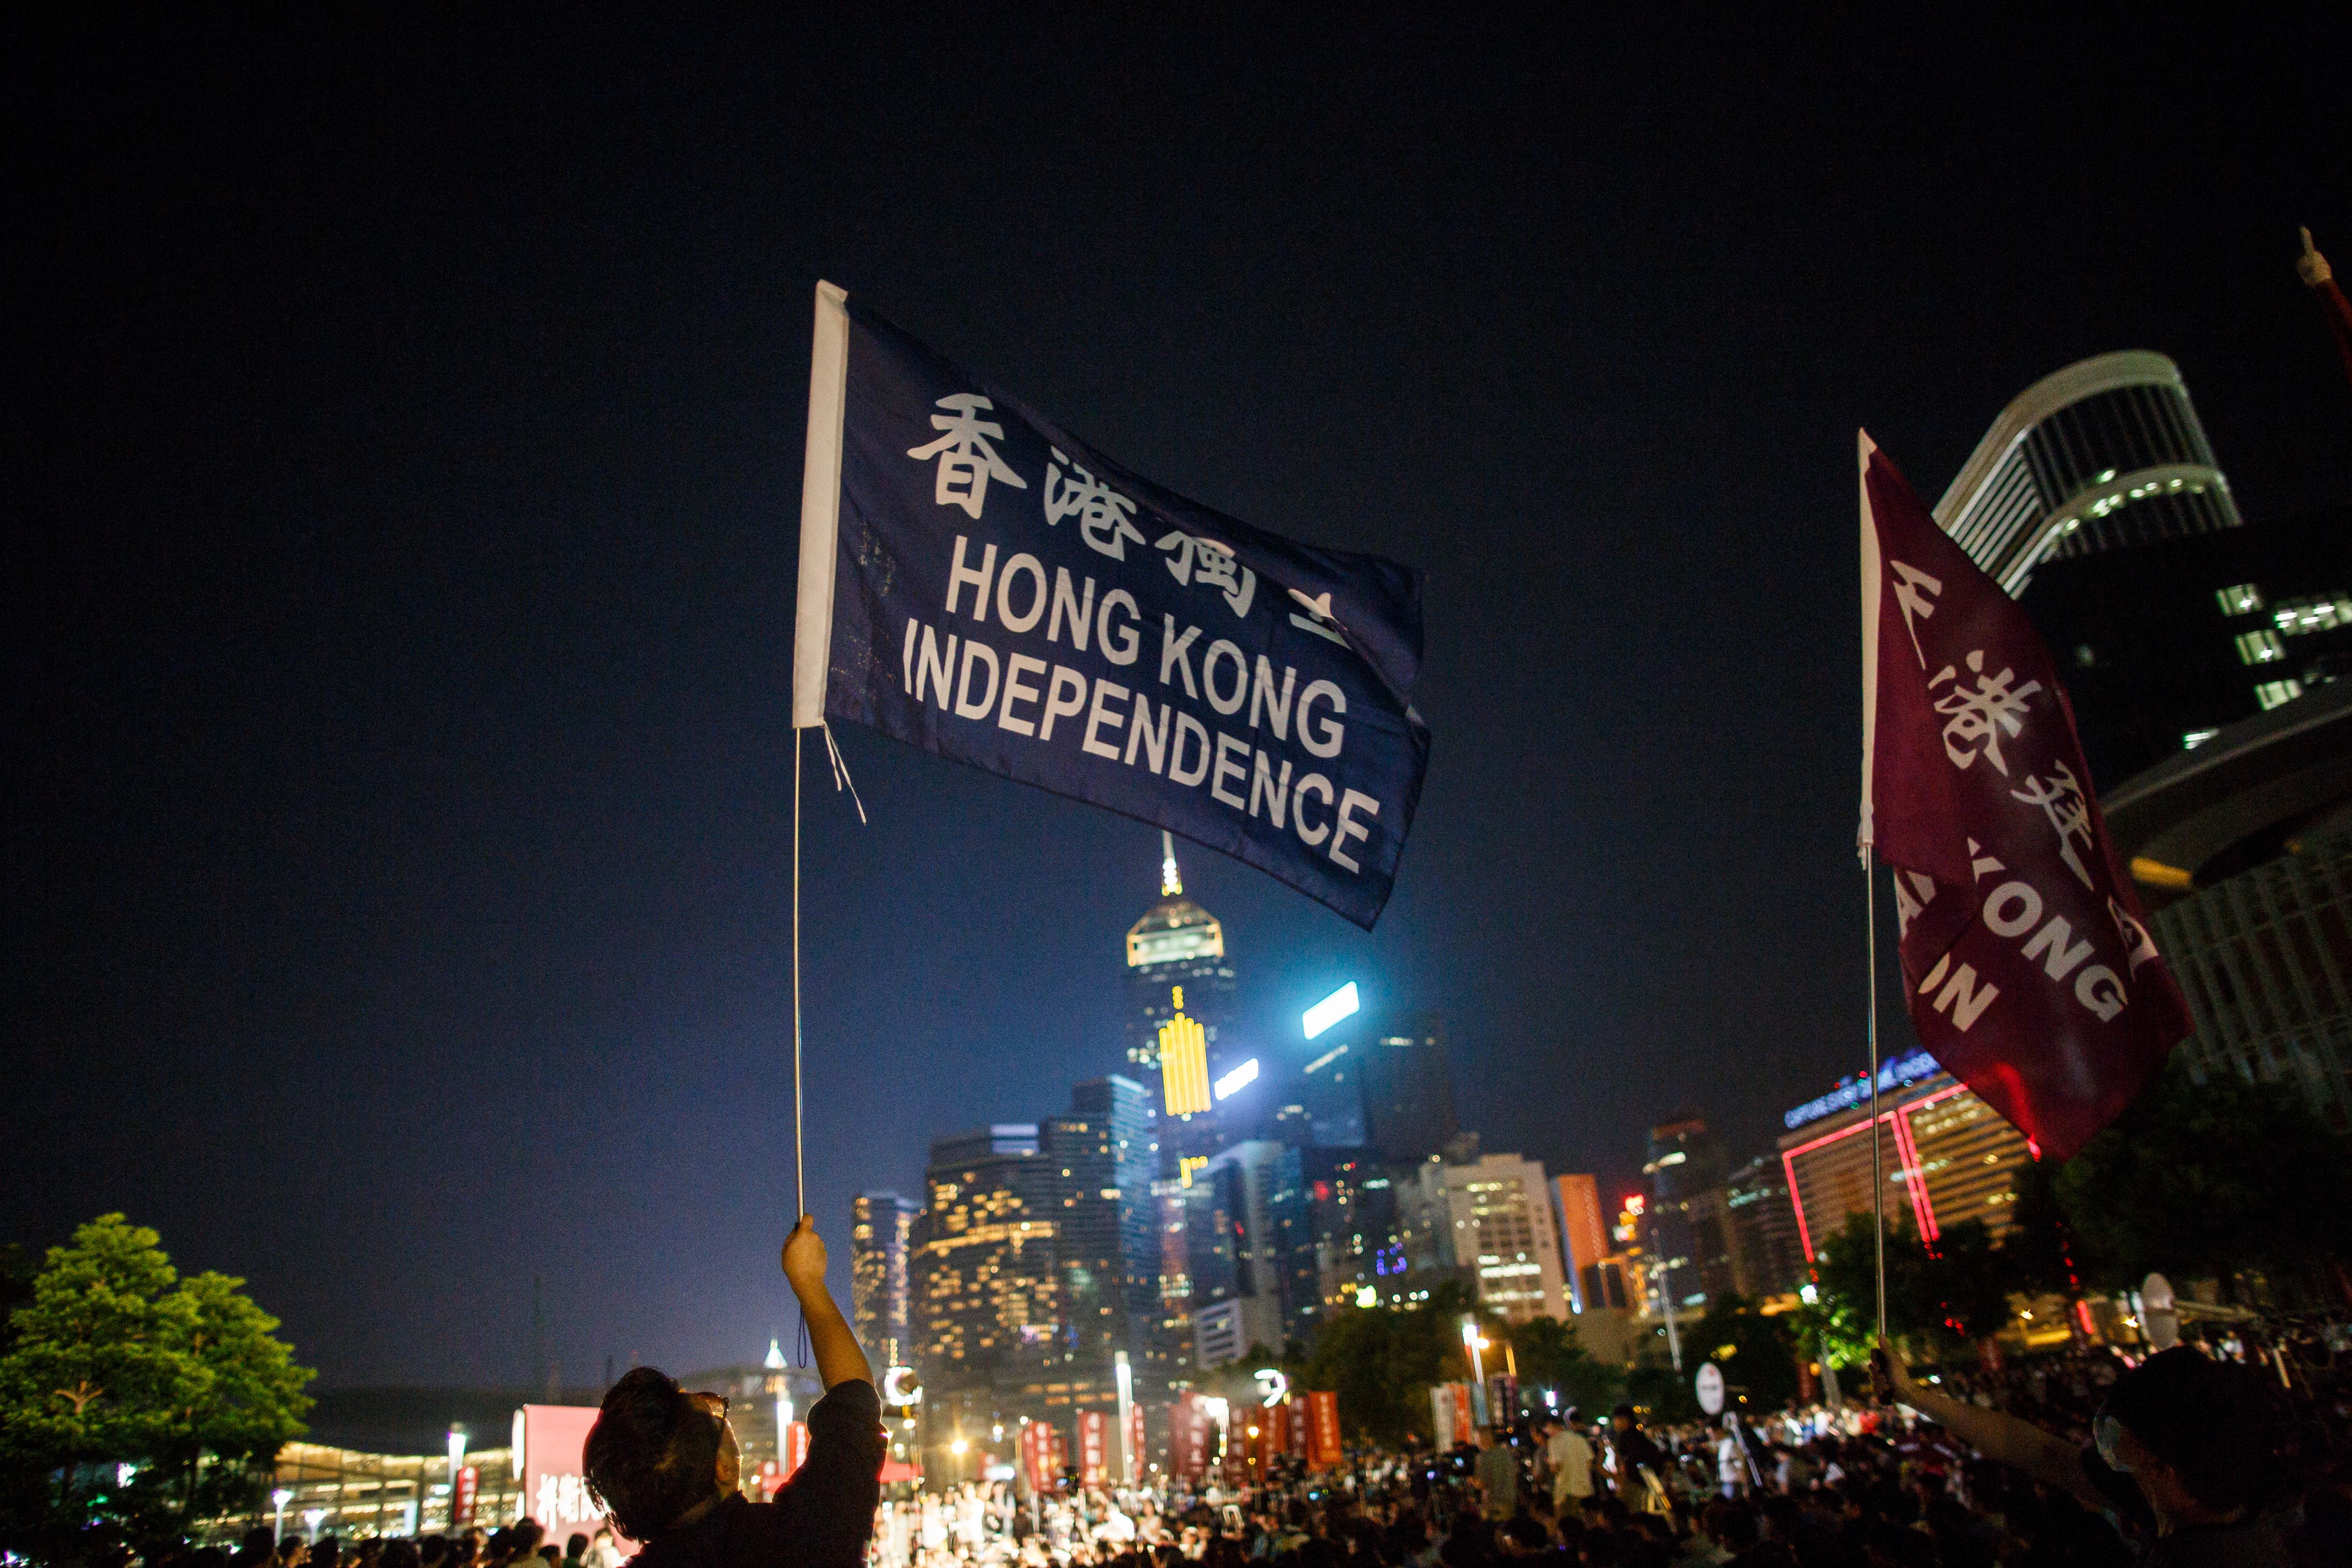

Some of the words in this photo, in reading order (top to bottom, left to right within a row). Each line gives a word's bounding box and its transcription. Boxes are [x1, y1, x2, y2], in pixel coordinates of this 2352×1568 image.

[903, 618, 1381, 874] INDEPENDENCE
[946, 535, 1141, 665] HONG
[1160, 613, 1346, 758] KONG
